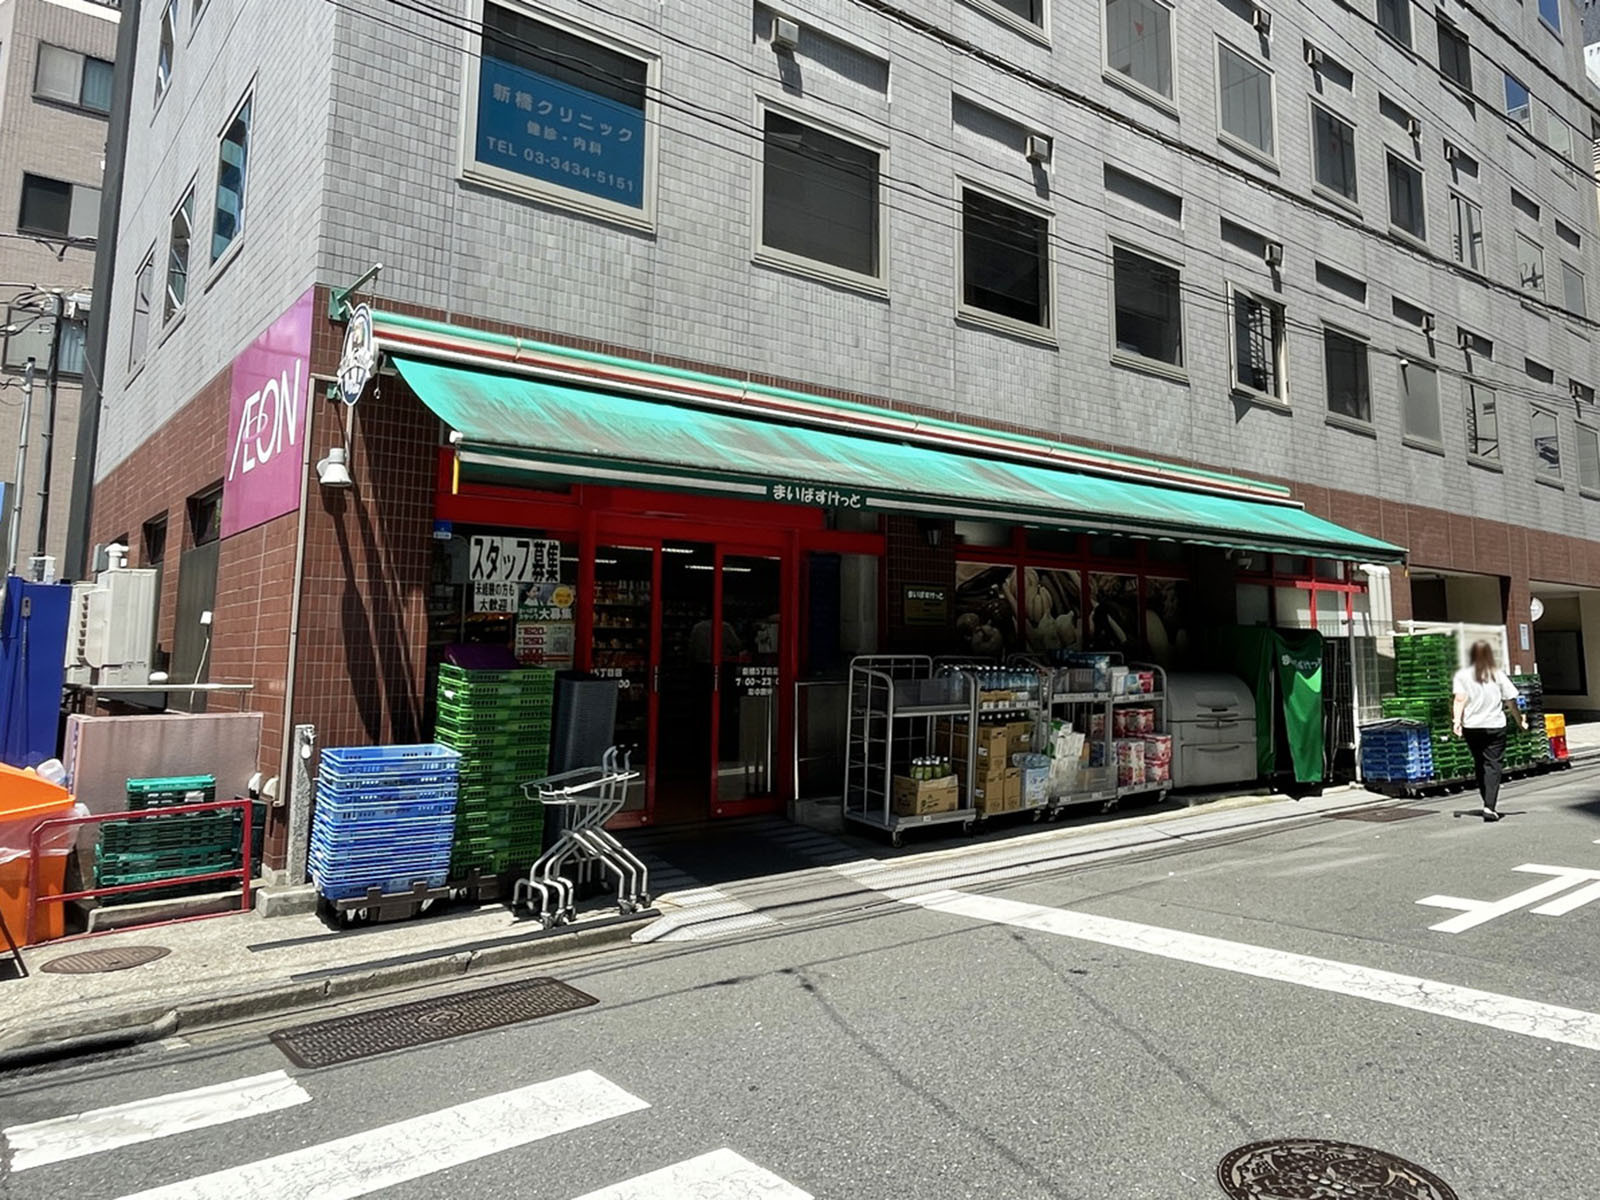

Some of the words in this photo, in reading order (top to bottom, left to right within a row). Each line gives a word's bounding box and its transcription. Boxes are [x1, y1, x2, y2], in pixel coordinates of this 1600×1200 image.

[492, 83, 632, 142] 新橋クリニック
[486, 136, 517, 157] TEL
[773, 485, 861, 508] まいばすけっと
[471, 538, 559, 582] スタッフ募集
[475, 583, 515, 596] 未経験の方も
